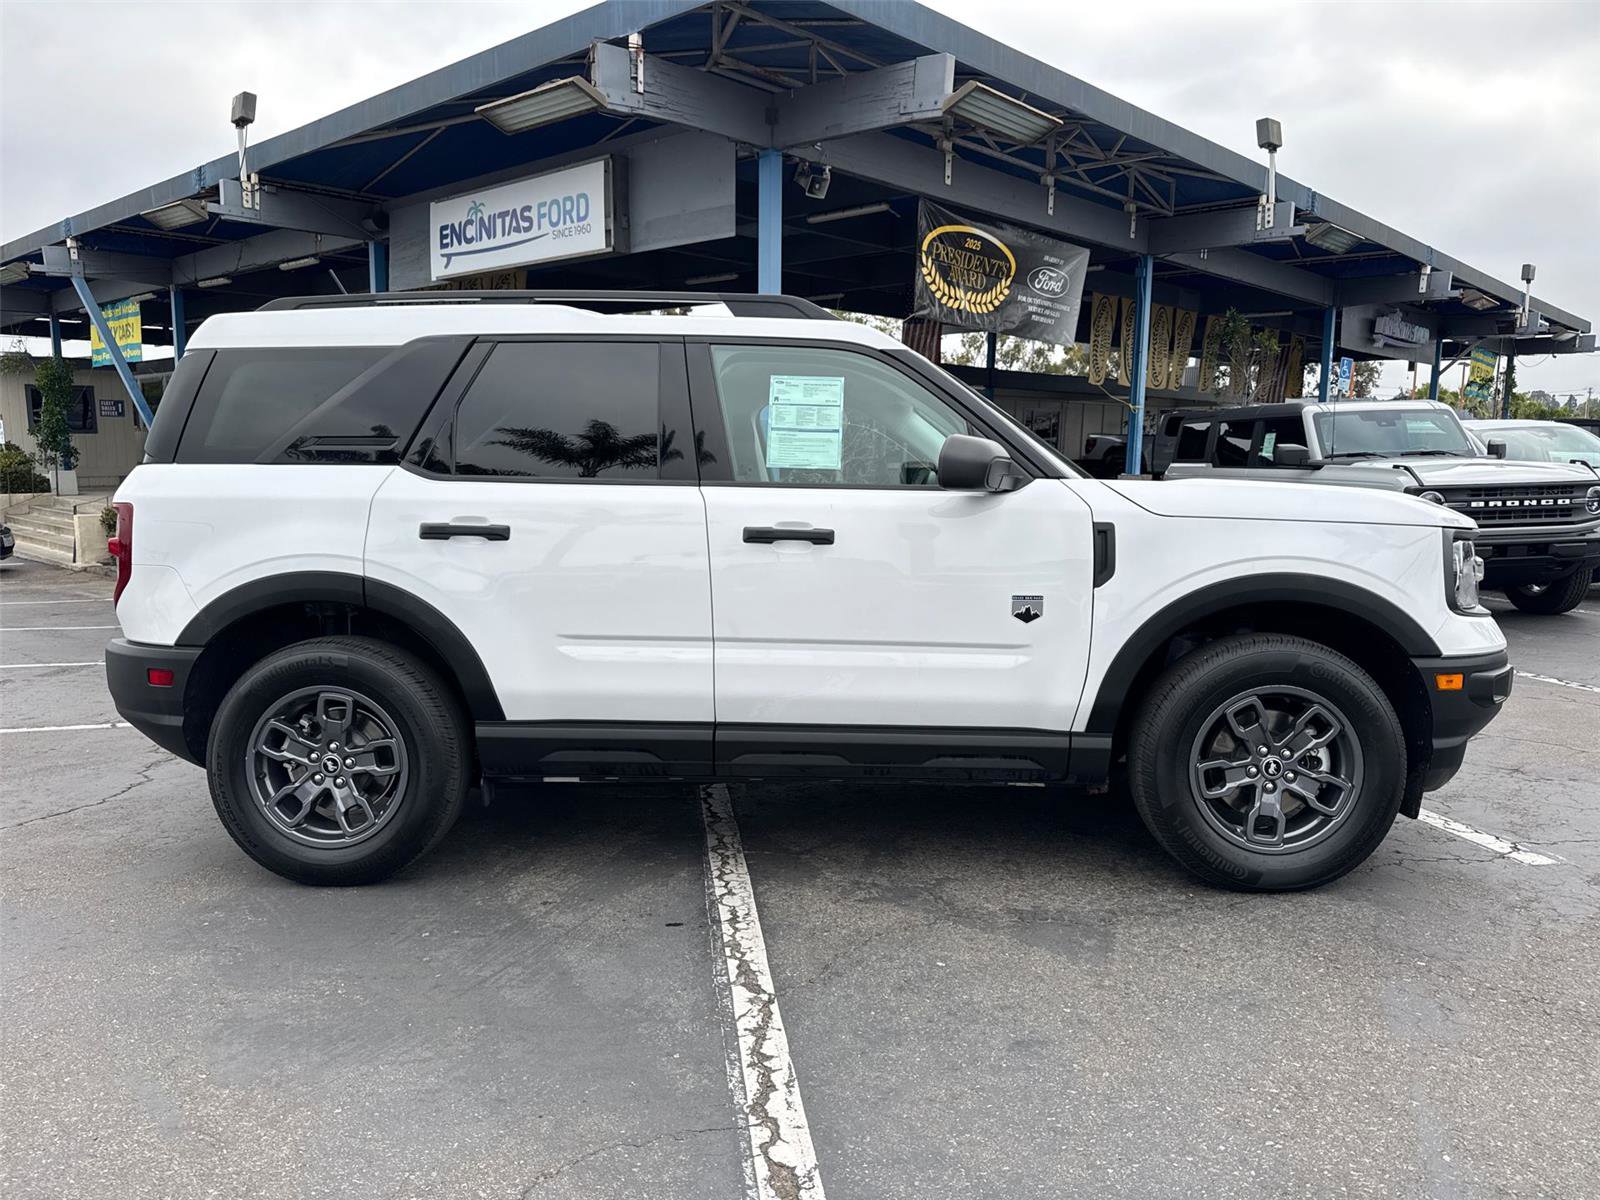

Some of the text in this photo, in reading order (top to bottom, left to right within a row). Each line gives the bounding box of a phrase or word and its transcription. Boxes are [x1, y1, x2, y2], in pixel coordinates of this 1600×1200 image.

[440, 192, 590, 250] ENCINITAS FORD
[552, 223, 592, 240] SINCE 1960
[964, 238, 982, 250] 2025
[931, 241, 1010, 278] PRESIDENT'S
[948, 266, 987, 290] AWARD
[1034, 269, 1065, 293] Ford
[1471, 499, 1570, 508] BRONCO
[1177, 826, 1249, 880] Continental
